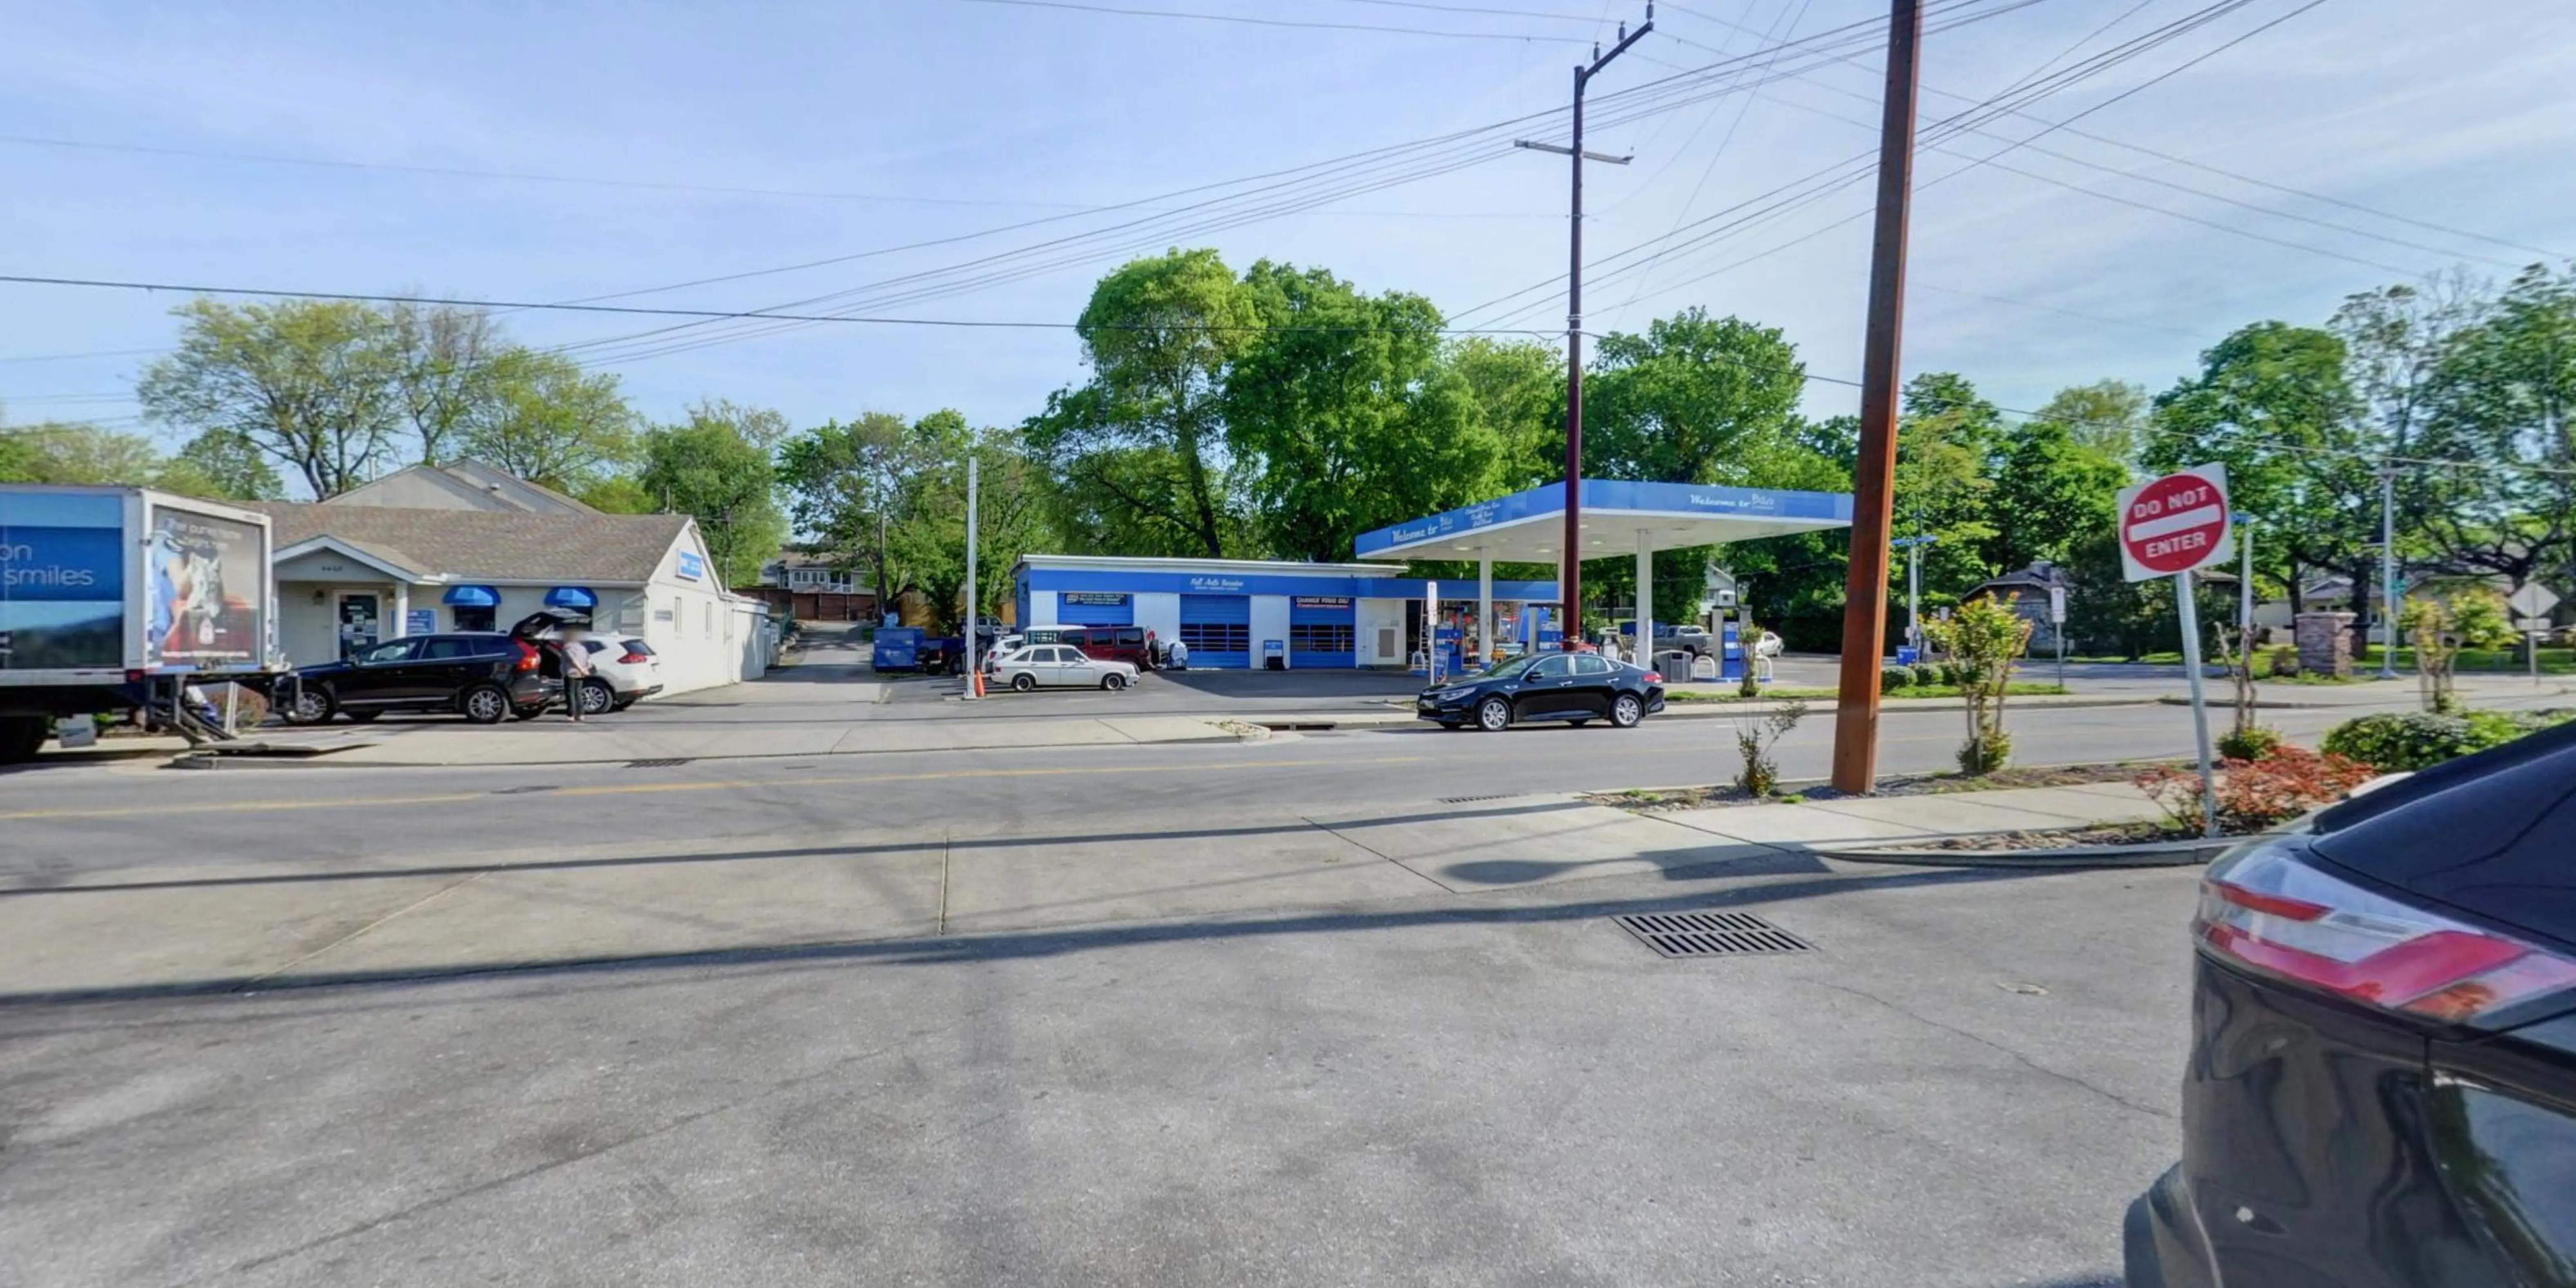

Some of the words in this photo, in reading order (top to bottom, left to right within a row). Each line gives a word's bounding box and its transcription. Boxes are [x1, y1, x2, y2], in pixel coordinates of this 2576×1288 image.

[1690, 494, 1736, 506] Welcome
[2133, 500, 2162, 519] DO
[2167, 486, 2208, 510] NOT
[1392, 529, 1426, 543] Welcome
[2146, 532, 2206, 558] ENTER
[4, 565, 95, 586] smiles
